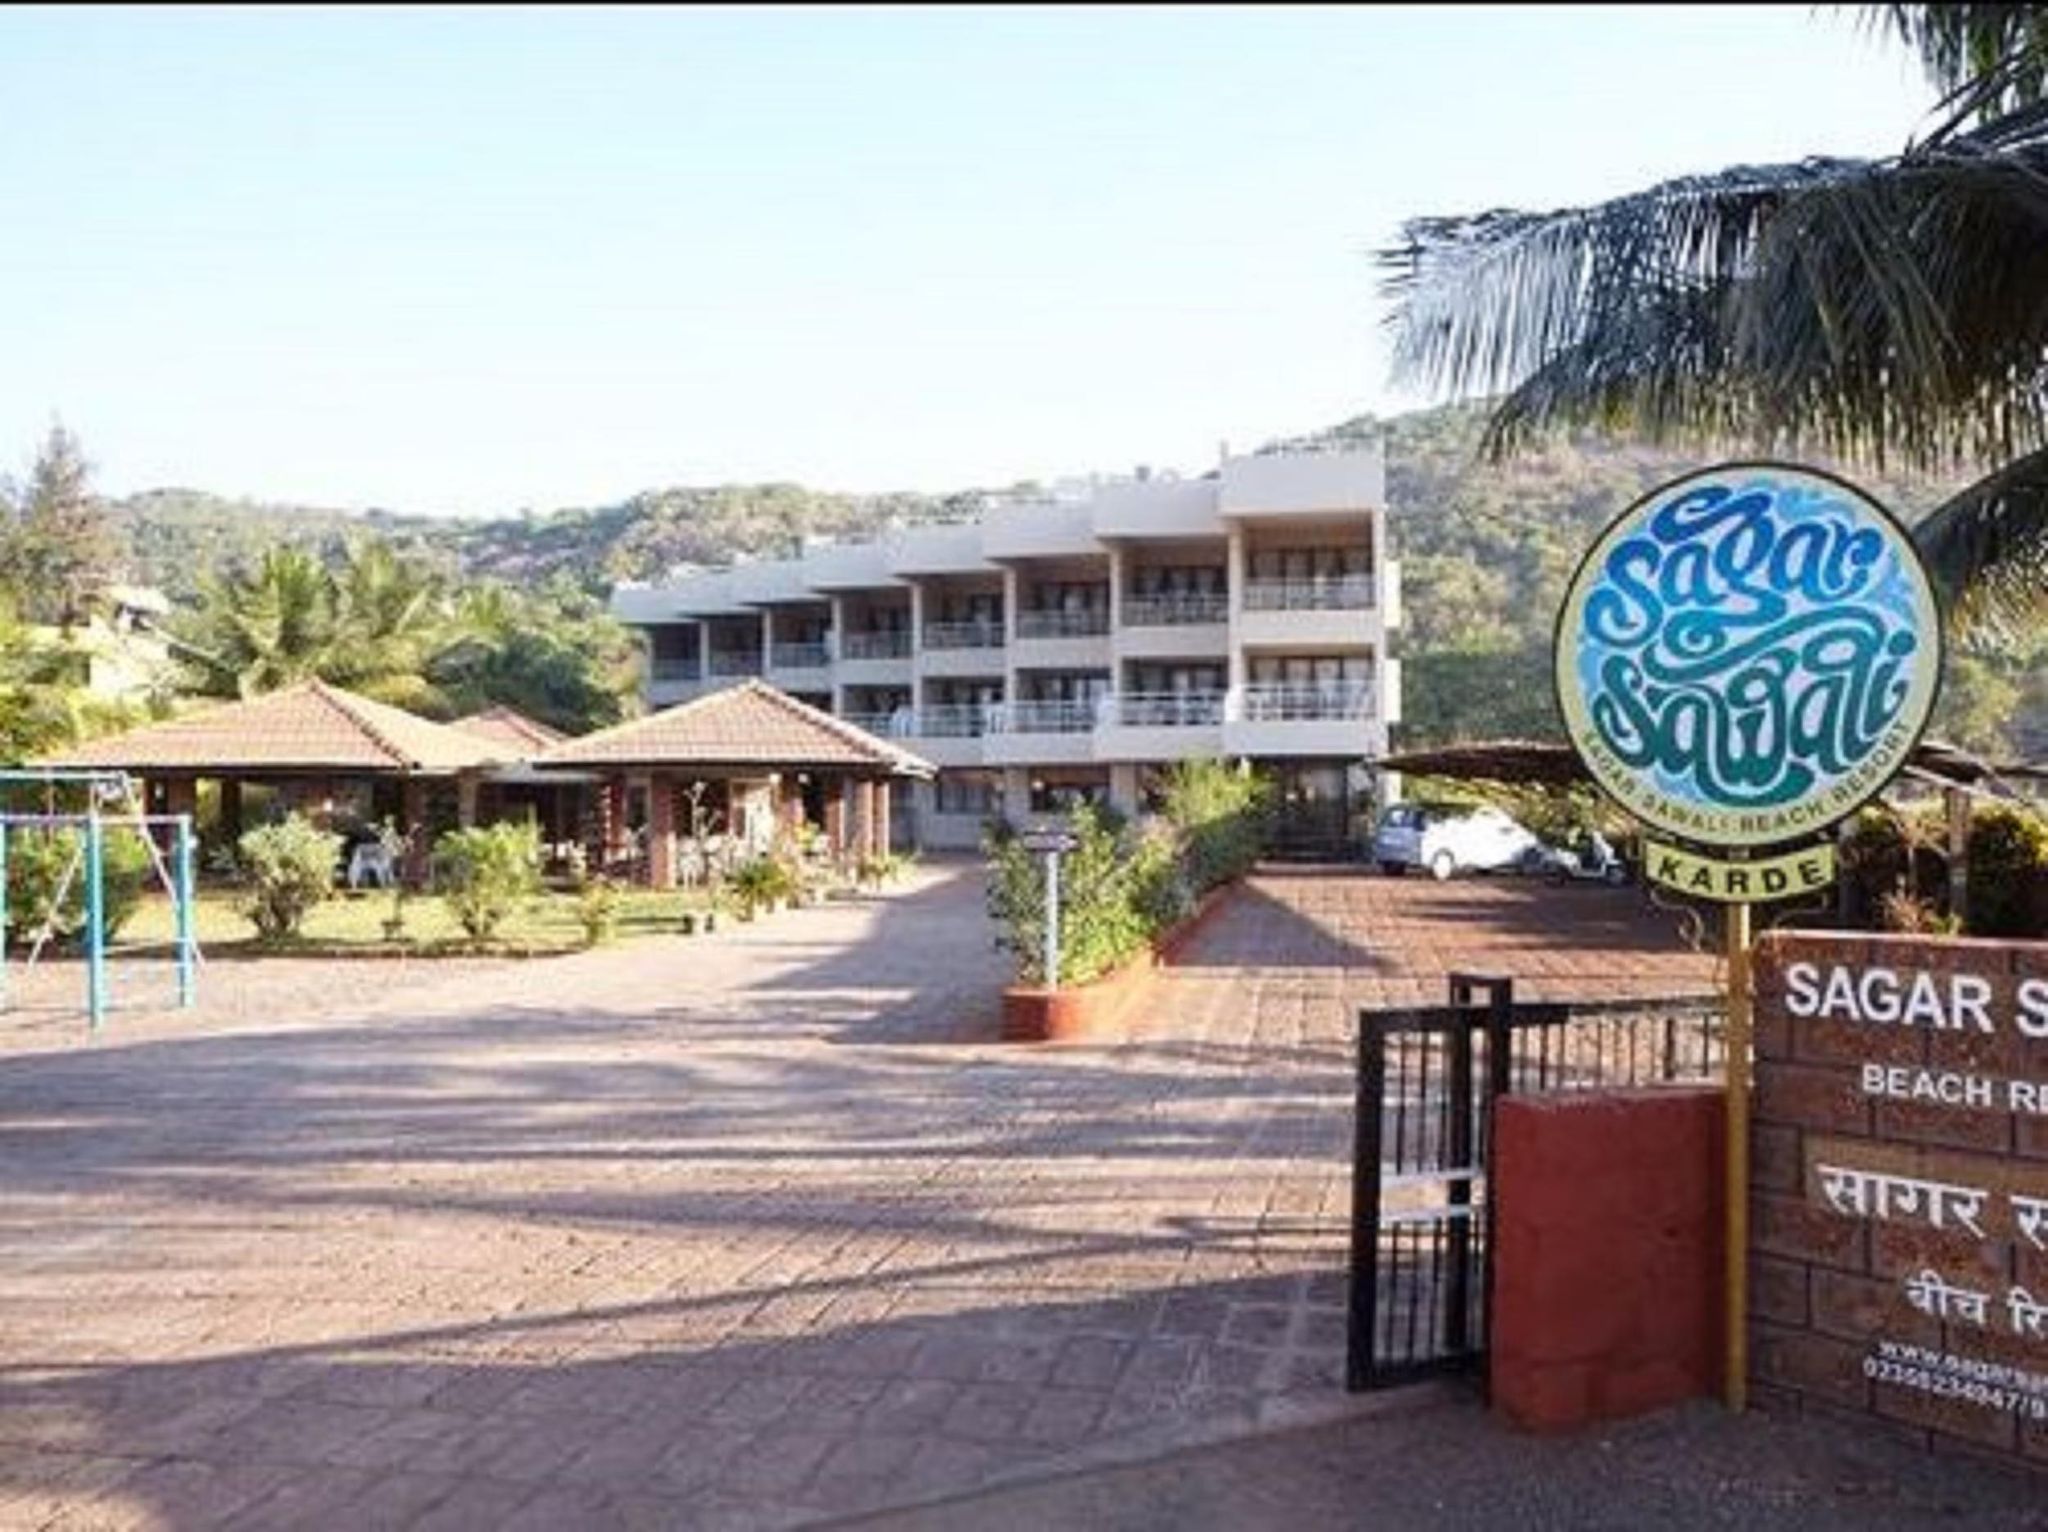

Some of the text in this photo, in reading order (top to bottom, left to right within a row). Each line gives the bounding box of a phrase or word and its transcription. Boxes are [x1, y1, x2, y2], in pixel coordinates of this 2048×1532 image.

[1657, 846, 1827, 894] KARDE
[1785, 962, 1995, 1033] SAGAR
[1862, 1063, 1992, 1108] BEACH
[1817, 1163, 1989, 1239] सागर
